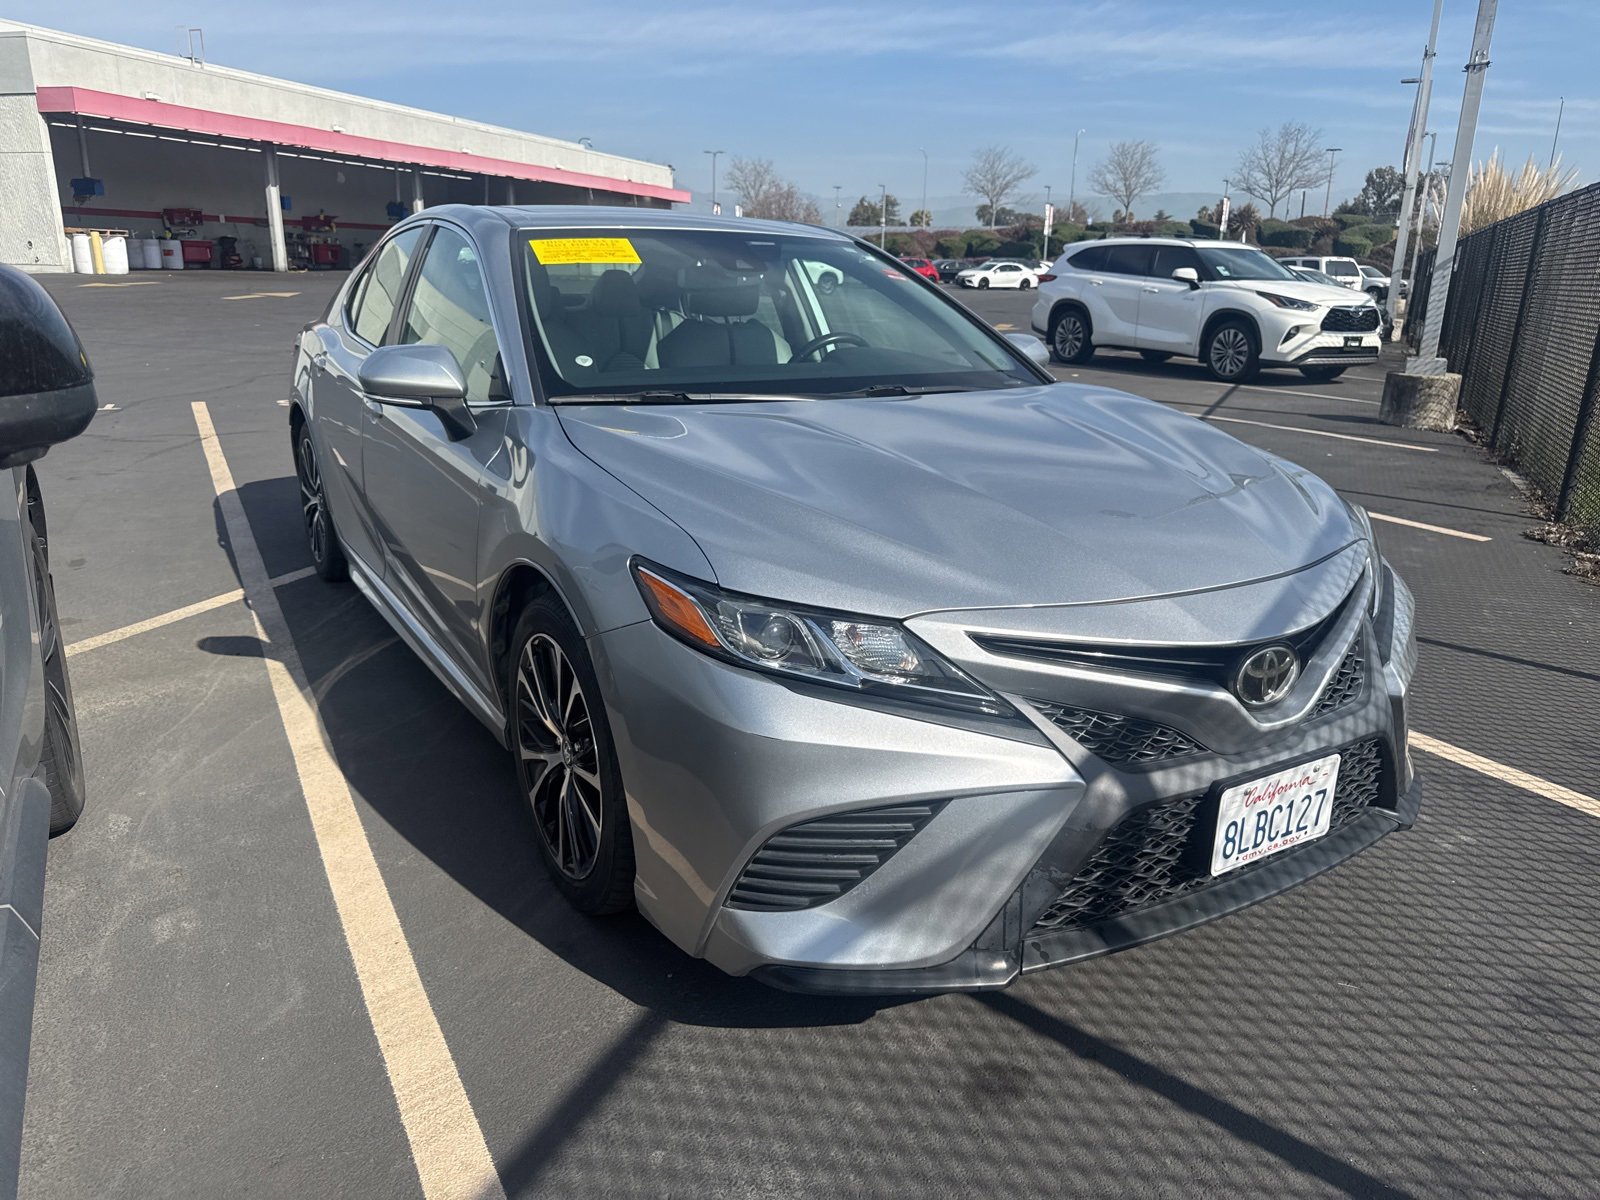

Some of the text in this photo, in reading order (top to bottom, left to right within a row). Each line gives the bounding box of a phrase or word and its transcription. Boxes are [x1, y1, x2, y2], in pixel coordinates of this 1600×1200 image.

[1245, 775, 1316, 808] California
[1222, 788, 1327, 860] 8LBC127
[1242, 834, 1301, 861] dmv.ca.gov
